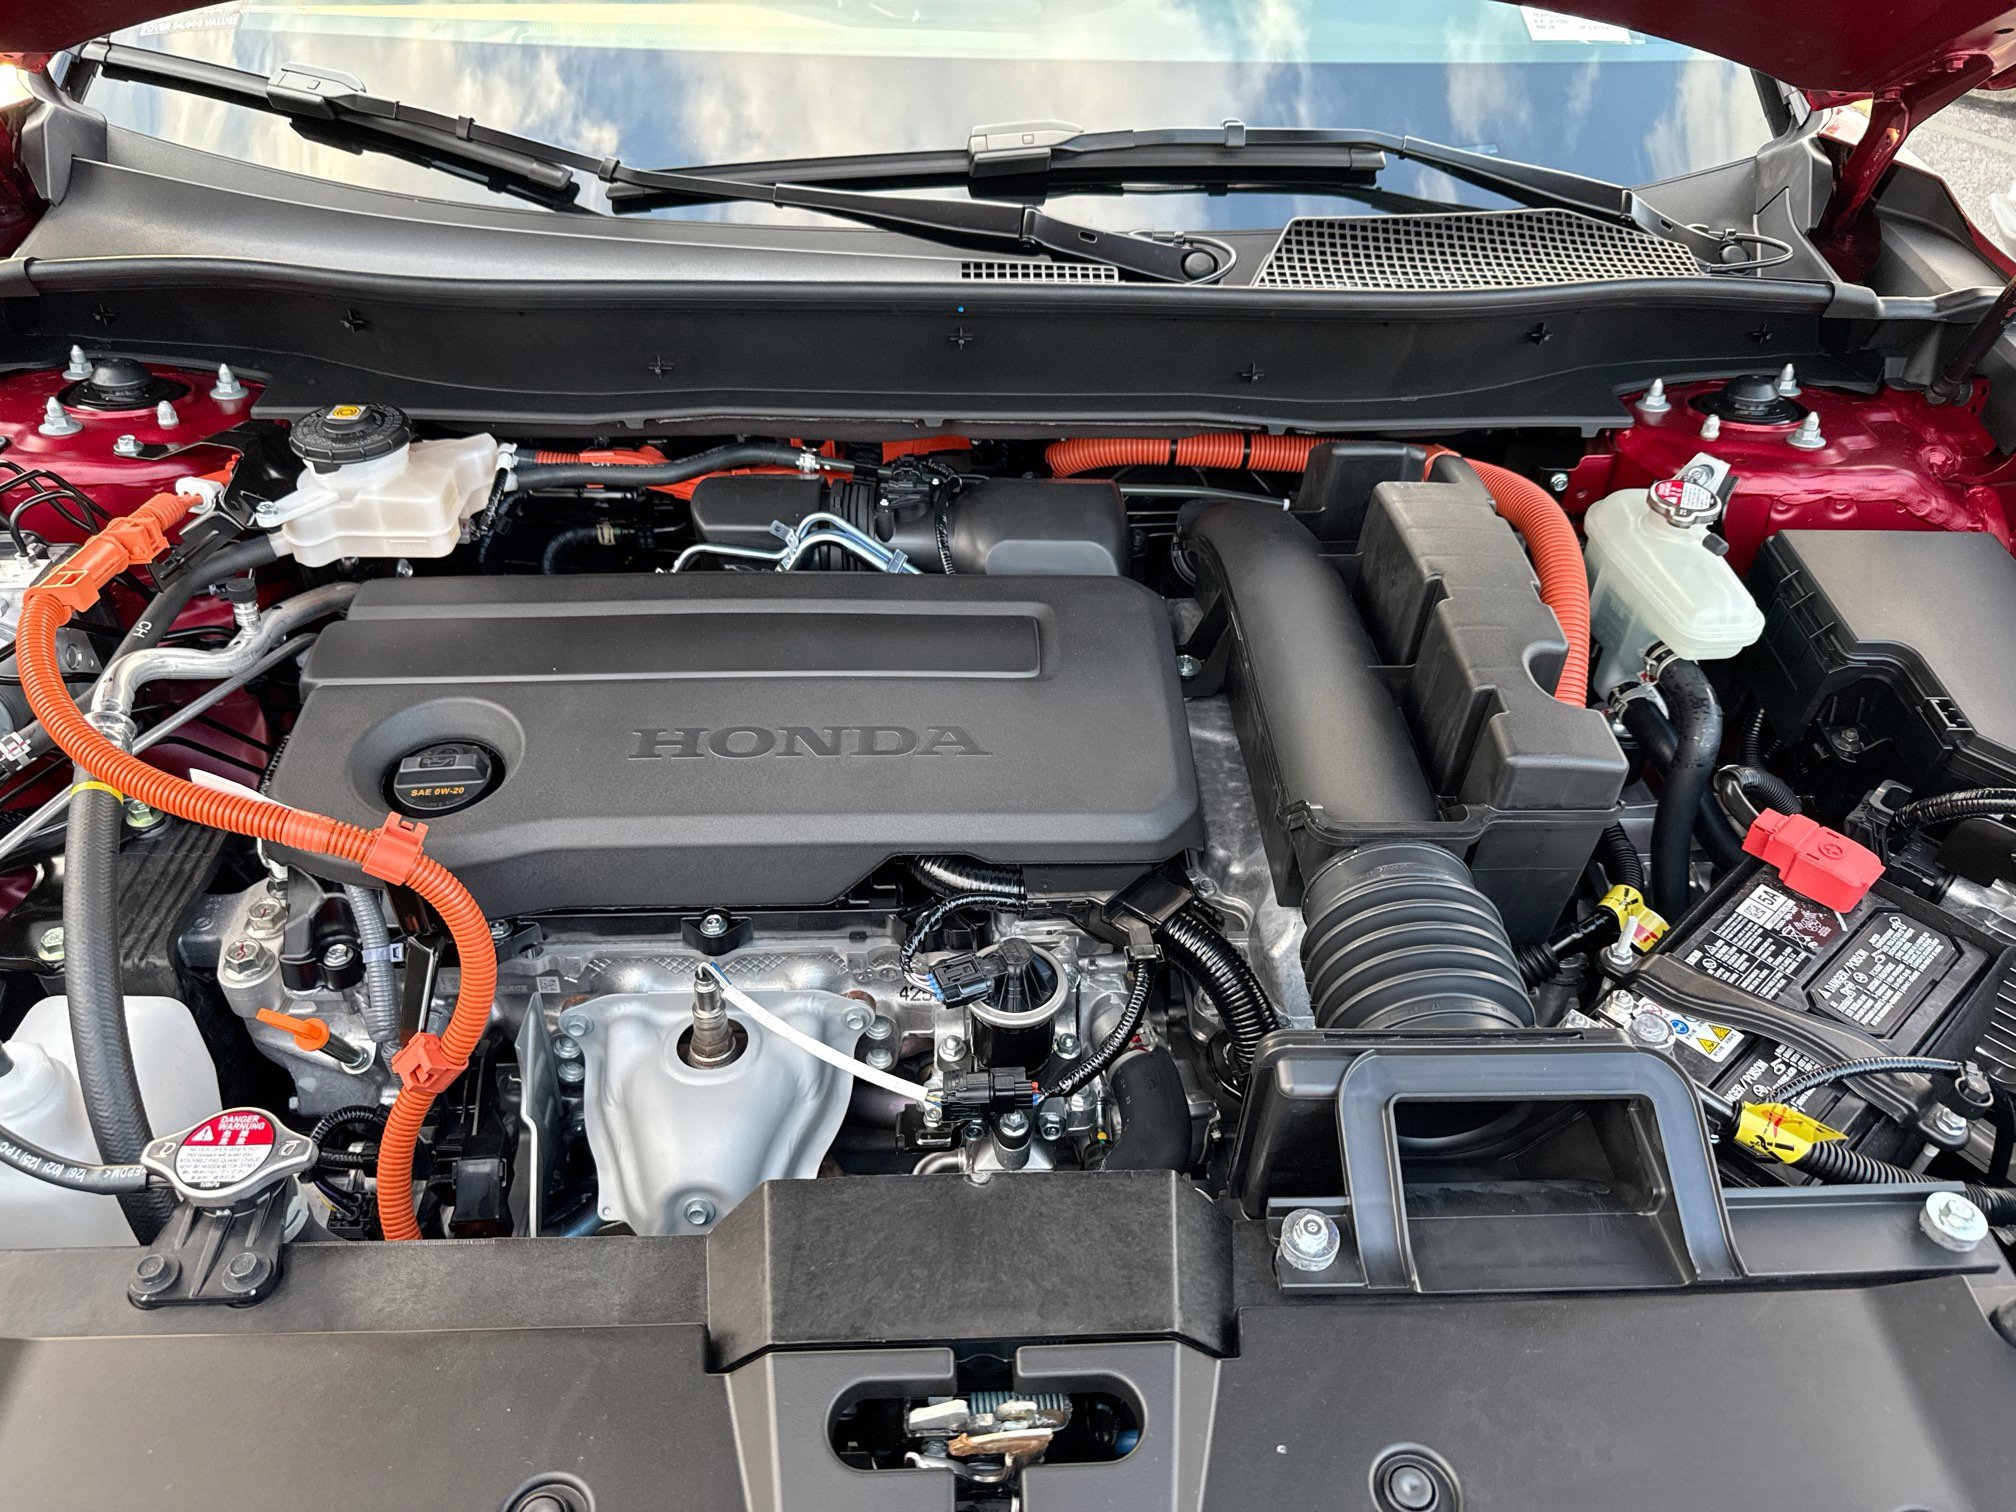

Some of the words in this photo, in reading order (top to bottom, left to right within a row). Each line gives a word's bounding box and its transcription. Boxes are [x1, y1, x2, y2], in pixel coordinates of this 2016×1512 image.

[628, 725, 992, 760] HONDA
[410, 788, 432, 797] SAE
[1758, 889, 1781, 906] 5A
[1824, 969, 1849, 994] DANGER
[1850, 948, 1870, 971] POISON
[1746, 1059, 1769, 1081] POISON
[218, 1121, 265, 1131] WARNUNG
[221, 1115, 260, 1123] DANGER
